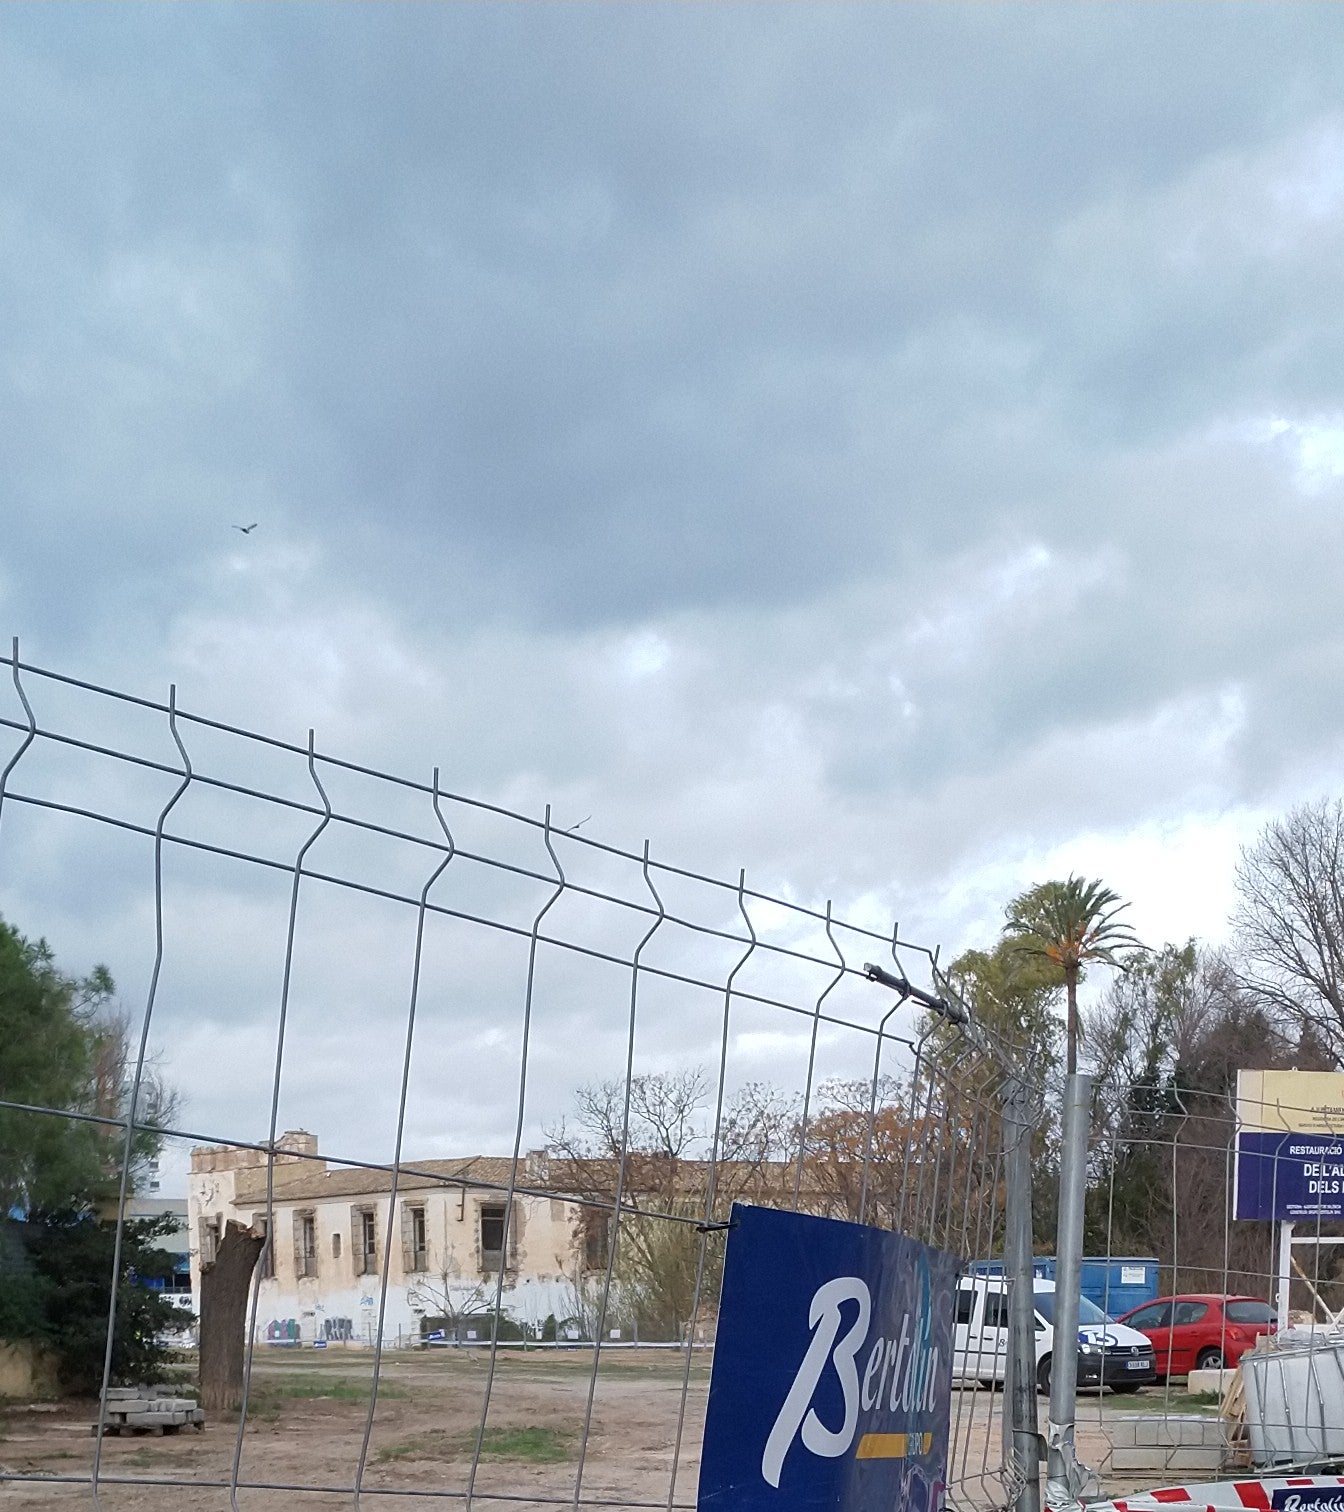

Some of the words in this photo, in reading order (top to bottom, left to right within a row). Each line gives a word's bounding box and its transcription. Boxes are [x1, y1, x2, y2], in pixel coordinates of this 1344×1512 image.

[1290, 1144, 1343, 1155] RESTAURACIÓ
[1303, 1163, 1320, 1177] DE
[1308, 1180, 1340, 1194] DELS
